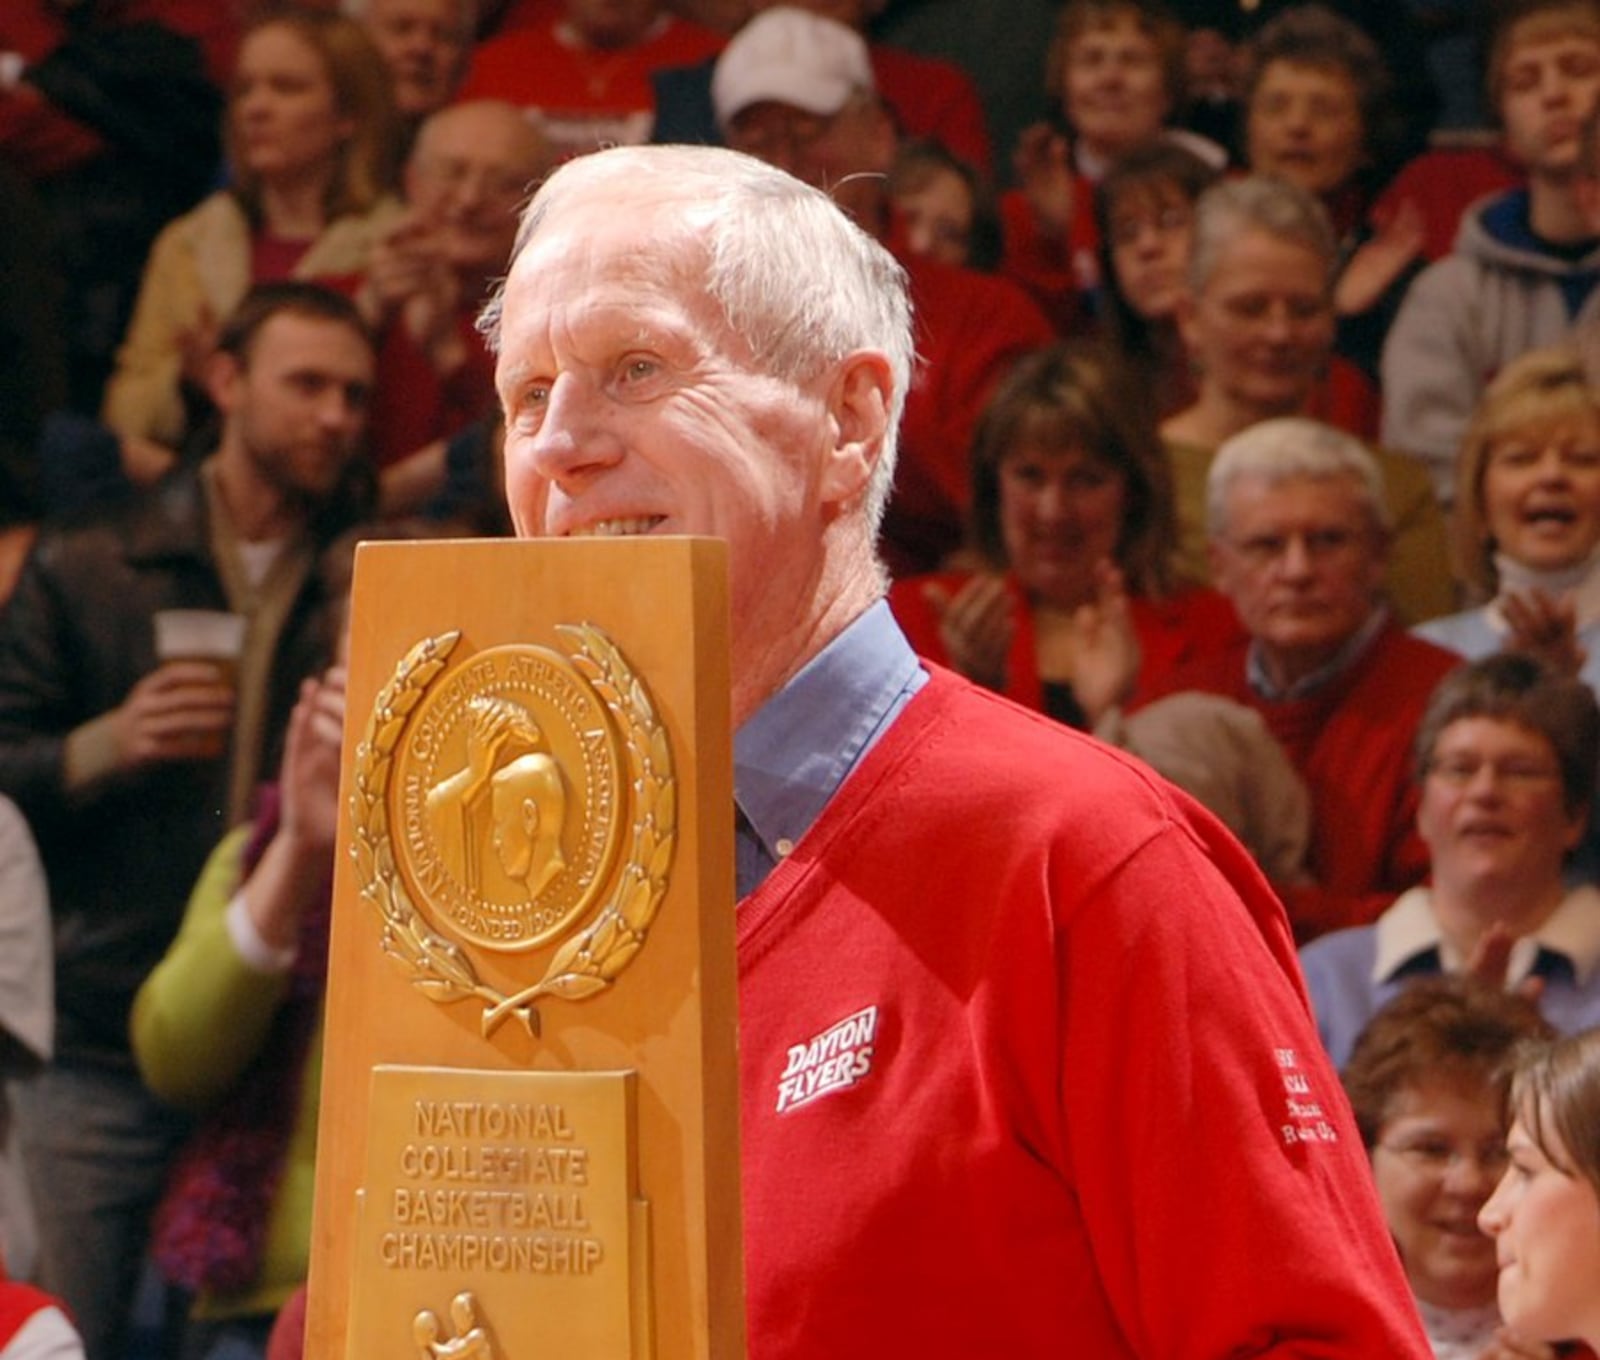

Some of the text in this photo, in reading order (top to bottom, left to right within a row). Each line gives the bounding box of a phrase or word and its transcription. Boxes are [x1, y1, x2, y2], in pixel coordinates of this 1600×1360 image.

[411, 660, 497, 761] COLLEGIATE
[506, 655, 591, 718] ATHLETIC
[405, 775, 444, 896] NATIONAL
[451, 901, 523, 939] FOUNDED
[781, 1005, 877, 1079] DAYTON
[776, 1047, 873, 1113] FLYERS
[414, 1099, 574, 1141] NATIONAL
[400, 1144, 588, 1186] COLLEGIATE
[393, 1187, 591, 1231] BASKETBALL
[379, 1231, 604, 1276] CHAMPIONSHIP
